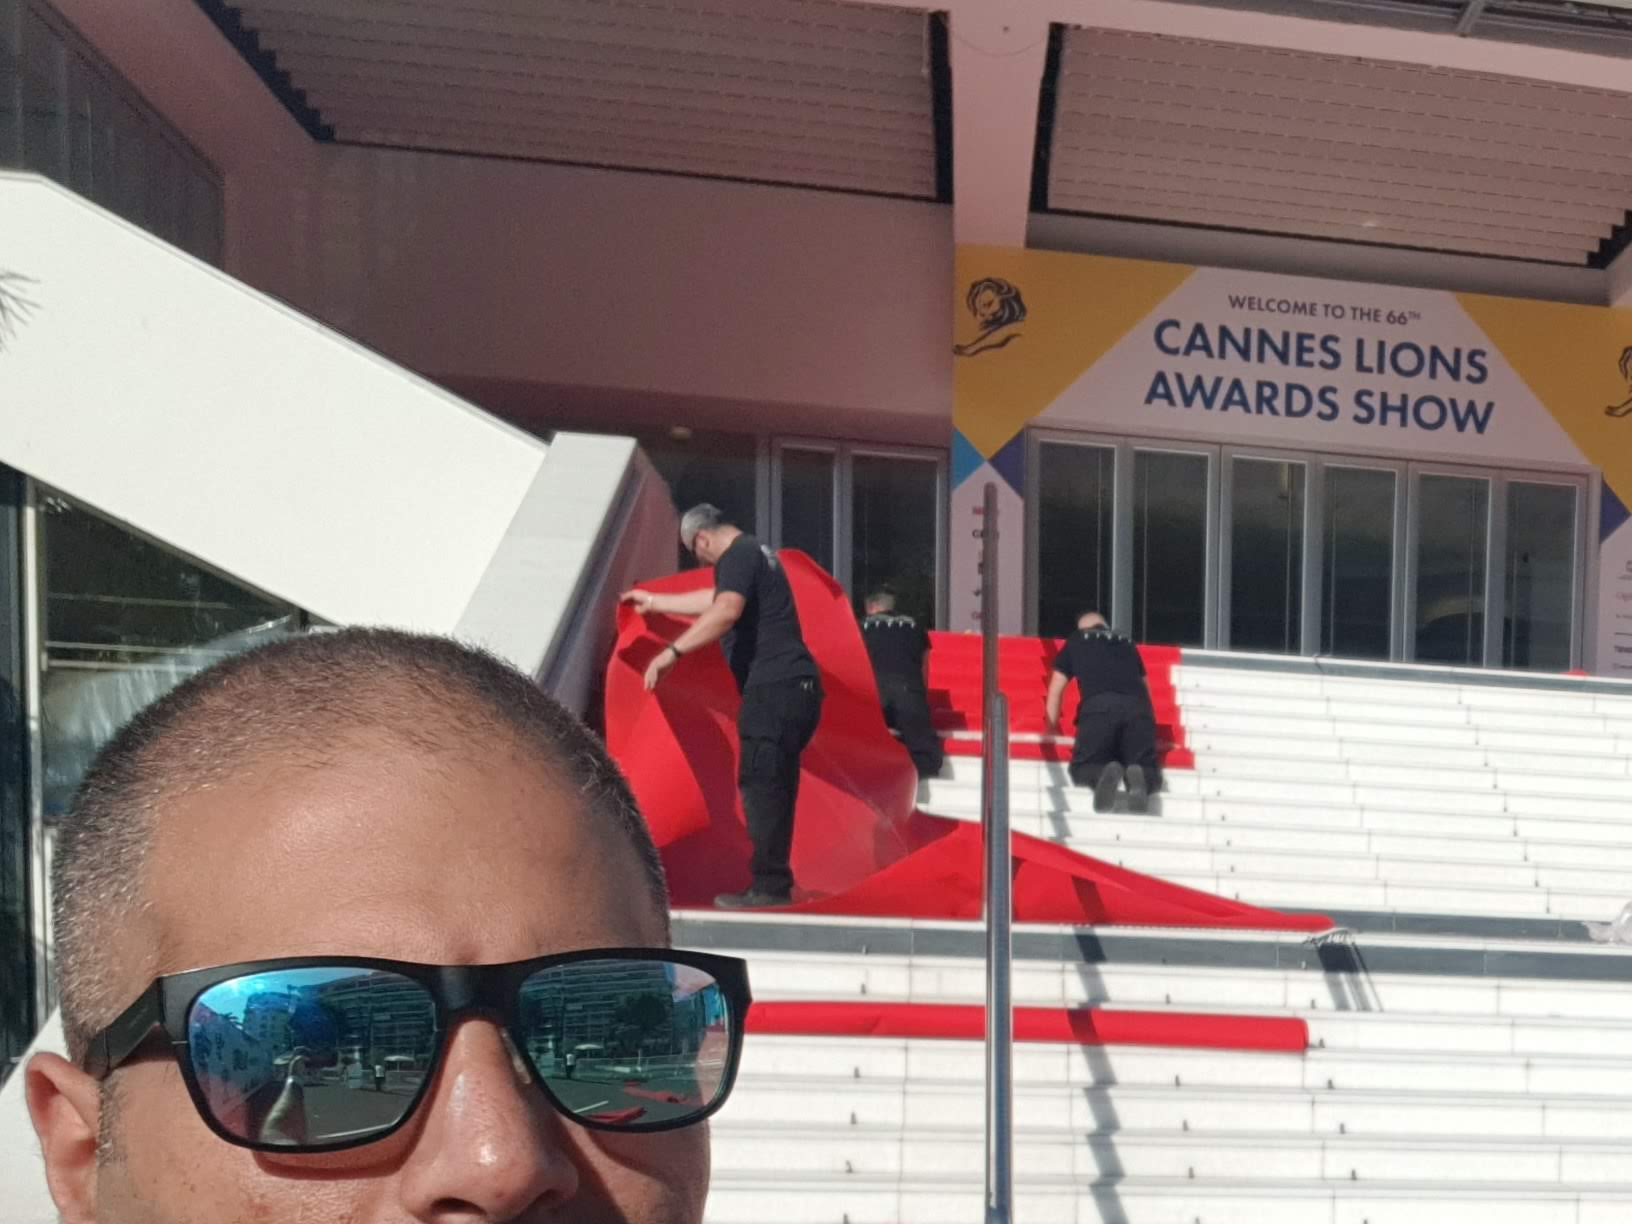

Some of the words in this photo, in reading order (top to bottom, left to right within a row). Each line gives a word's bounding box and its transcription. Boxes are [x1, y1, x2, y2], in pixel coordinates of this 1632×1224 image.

[1228, 295, 1318, 317] WELCOME
[1323, 304, 1345, 319] TO
[1350, 306, 1381, 323] THE
[1154, 319, 1342, 370] CANNES
[1355, 337, 1489, 385] LIONS
[1144, 370, 1341, 422] AWARDS
[1352, 389, 1495, 434] SHOW
